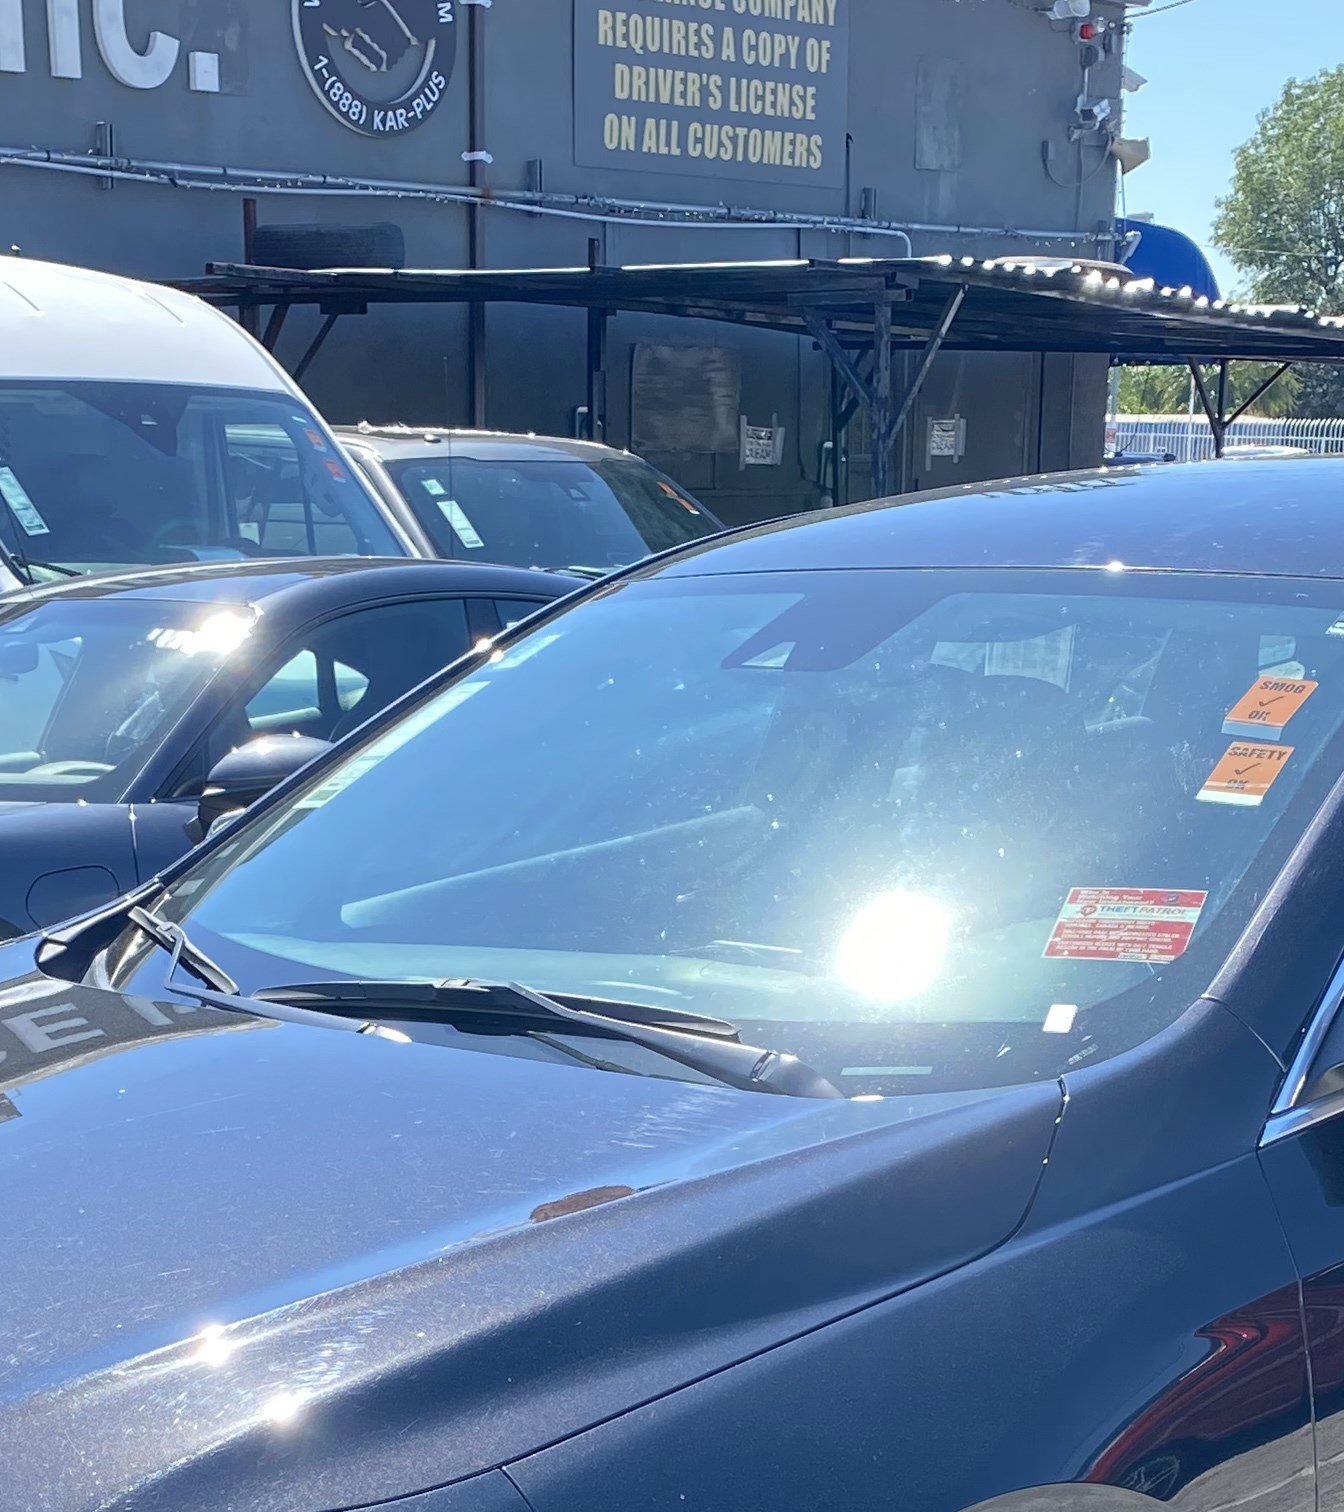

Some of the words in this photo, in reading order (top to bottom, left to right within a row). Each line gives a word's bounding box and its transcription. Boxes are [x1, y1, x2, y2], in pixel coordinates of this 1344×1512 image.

[598, 10, 714, 59] REQUIRES
[721, 27, 736, 62] A
[742, 29, 800, 69] COPY
[806, 37, 831, 73] OF
[313, 55, 367, 124] 1-(888)
[372, 71, 446, 131] KAR-PLUS
[614, 63, 722, 110] DRIVER'S
[729, 77, 816, 120] LICENSE
[604, 113, 636, 151] ON
[642, 117, 681, 156] ALL
[687, 121, 822, 169] CUSTOMERS
[1248, 710, 1271, 721] OK
[1259, 681, 1307, 694] SMOG
[1228, 746, 1288, 761] SAFETY
